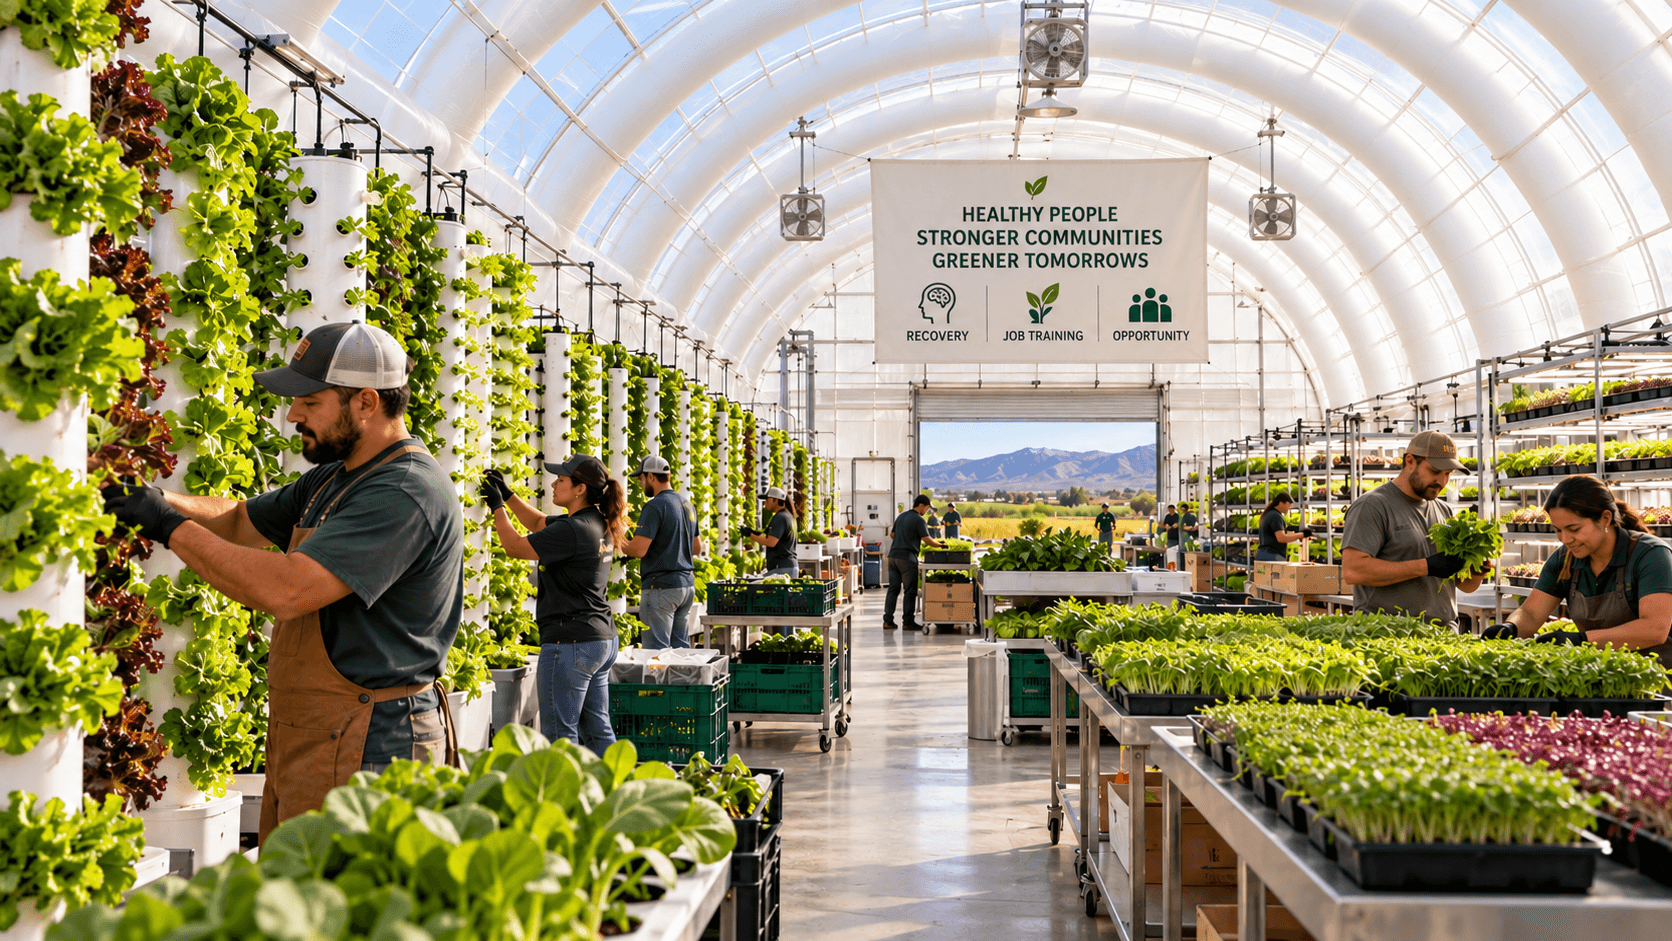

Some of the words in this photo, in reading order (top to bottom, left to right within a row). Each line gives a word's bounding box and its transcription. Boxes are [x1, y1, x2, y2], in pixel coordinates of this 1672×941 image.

[962, 206, 1044, 223] HEALTHY
[1049, 206, 1118, 223] PEOPLE
[916, 229, 1019, 246] STRONGER
[1025, 229, 1163, 246] COMMUNITIES
[932, 252, 1019, 269] GREENER
[1025, 252, 1149, 269] TOMORROWS
[906, 330, 969, 342] RECOVERY
[1003, 330, 1025, 342] JOB
[1028, 330, 1084, 342] TRAINING
[1112, 330, 1190, 342] OPPORTUNITY
